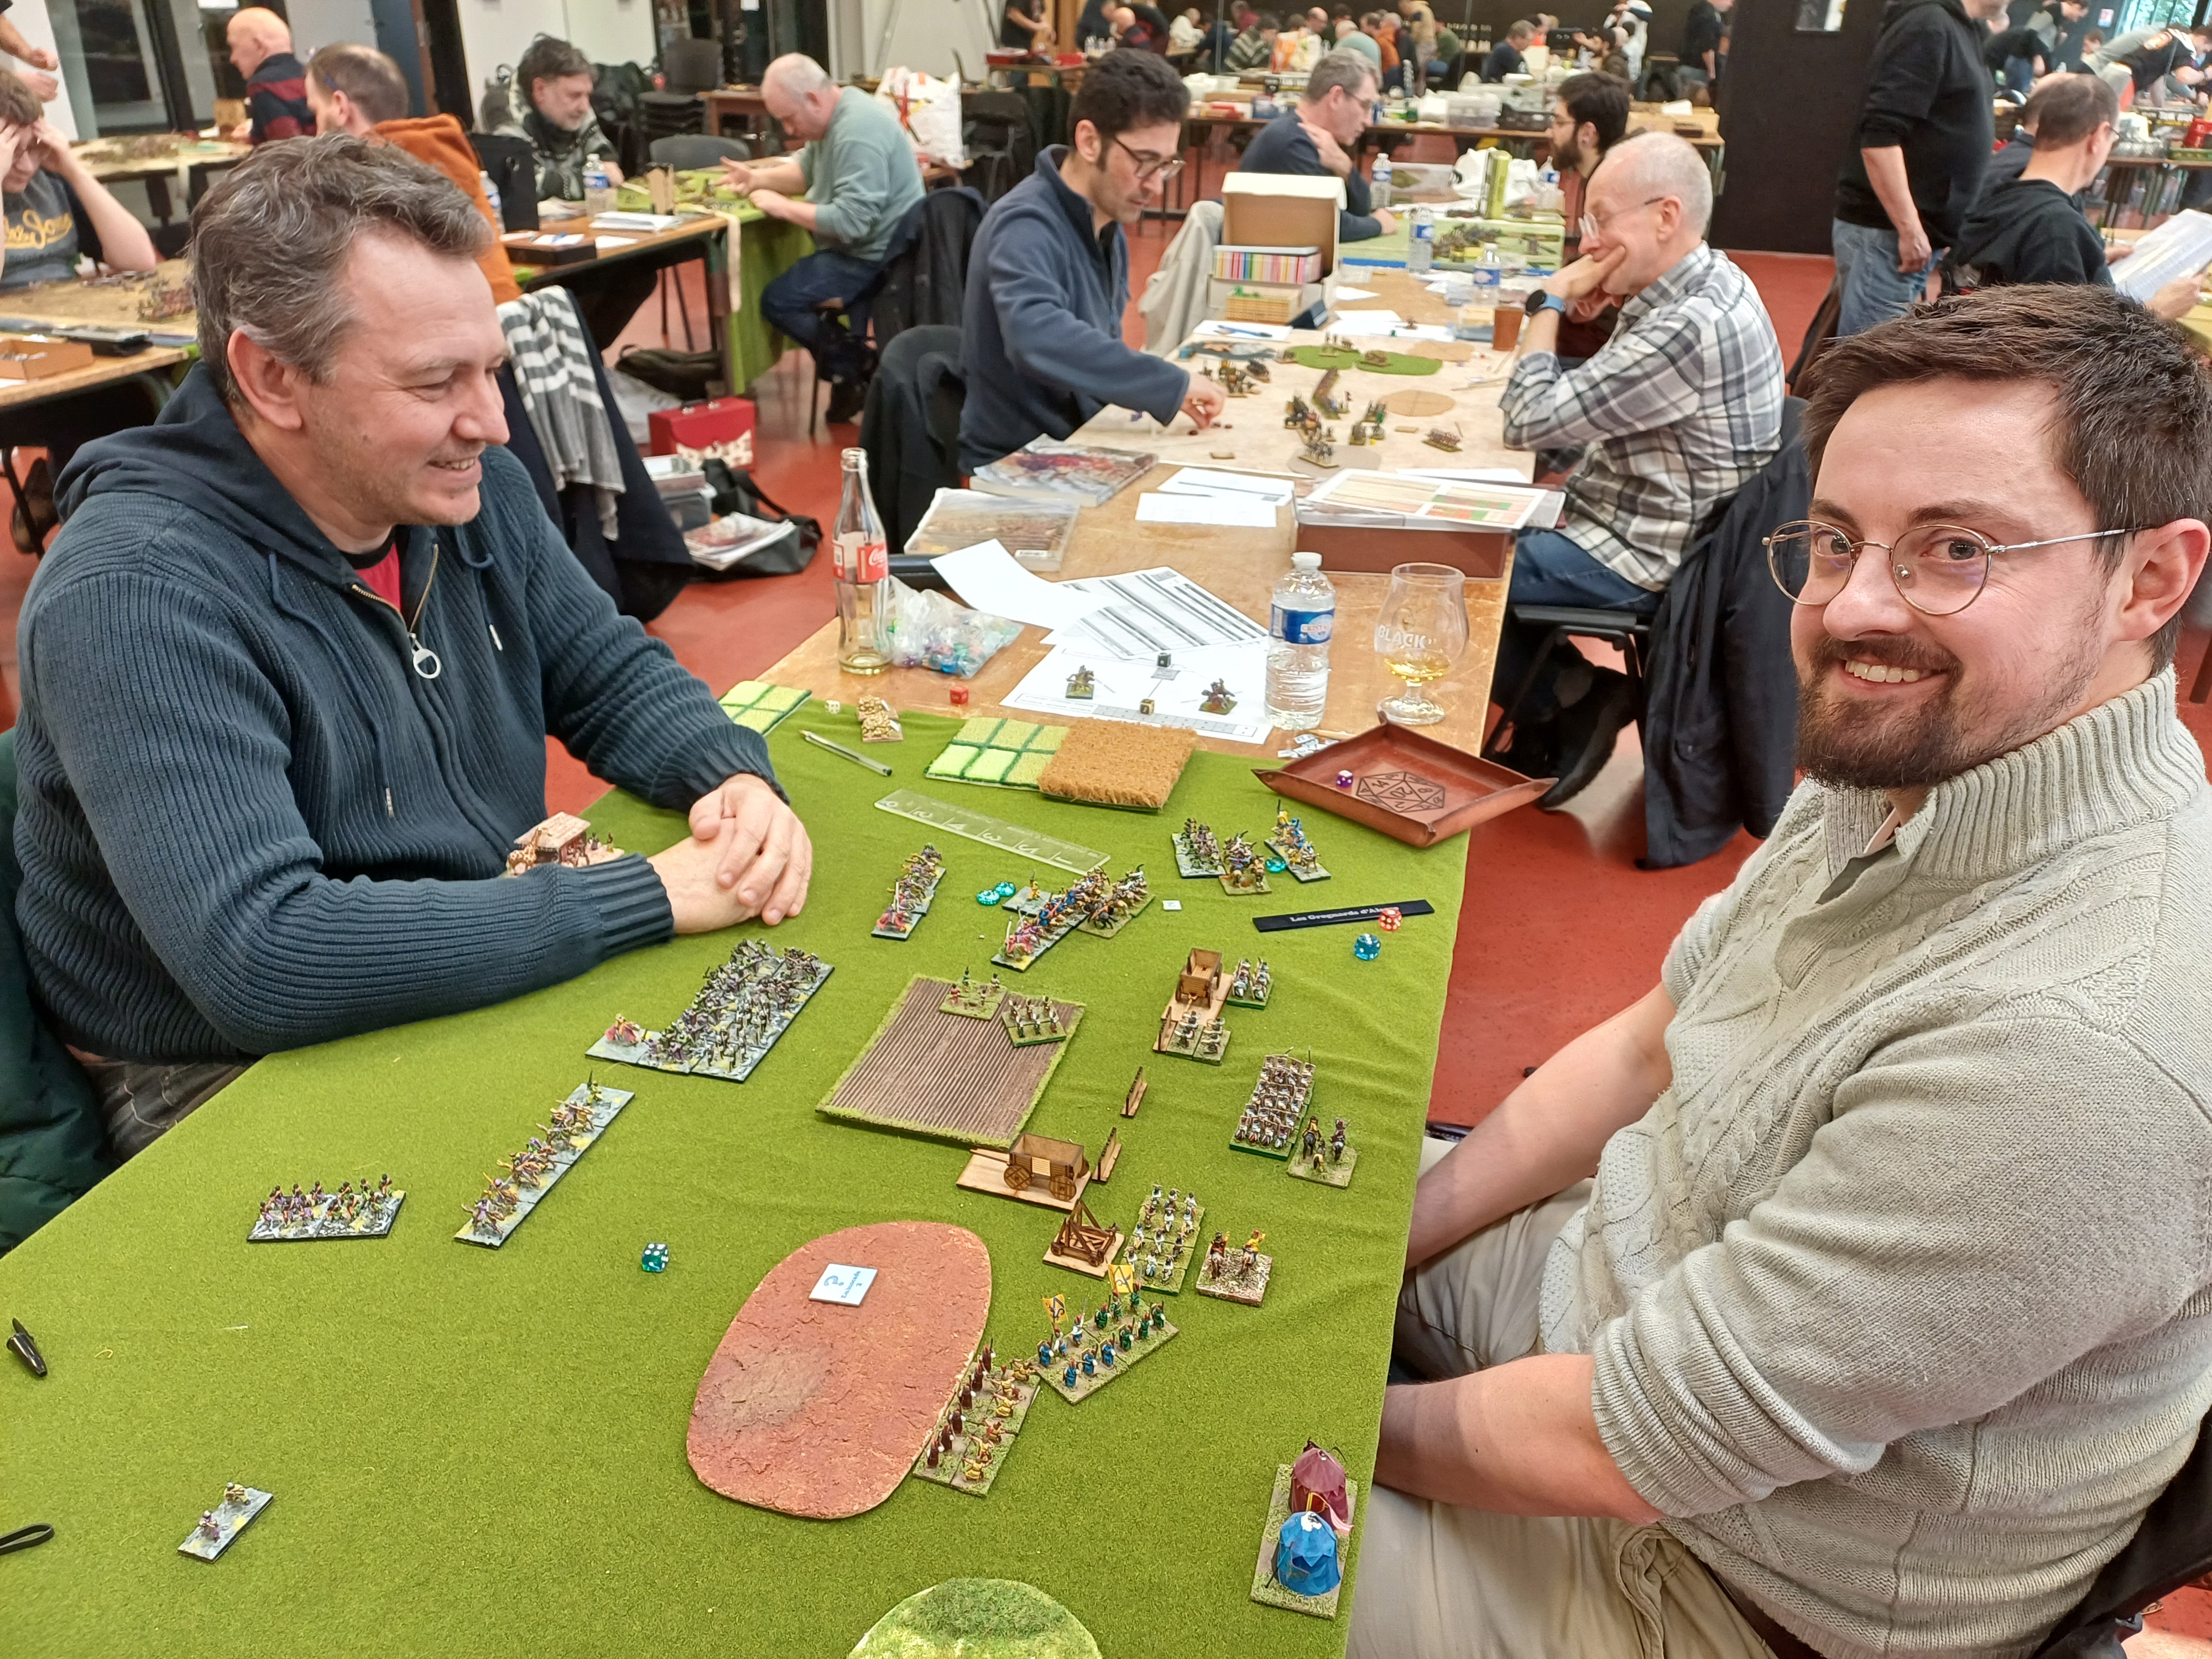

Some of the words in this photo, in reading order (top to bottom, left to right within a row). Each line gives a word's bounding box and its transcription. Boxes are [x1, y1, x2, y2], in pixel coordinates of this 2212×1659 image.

[1378, 624, 1426, 649] BLACK
[1390, 786, 1413, 798] 20
[1307, 910, 1359, 920] Grognards
